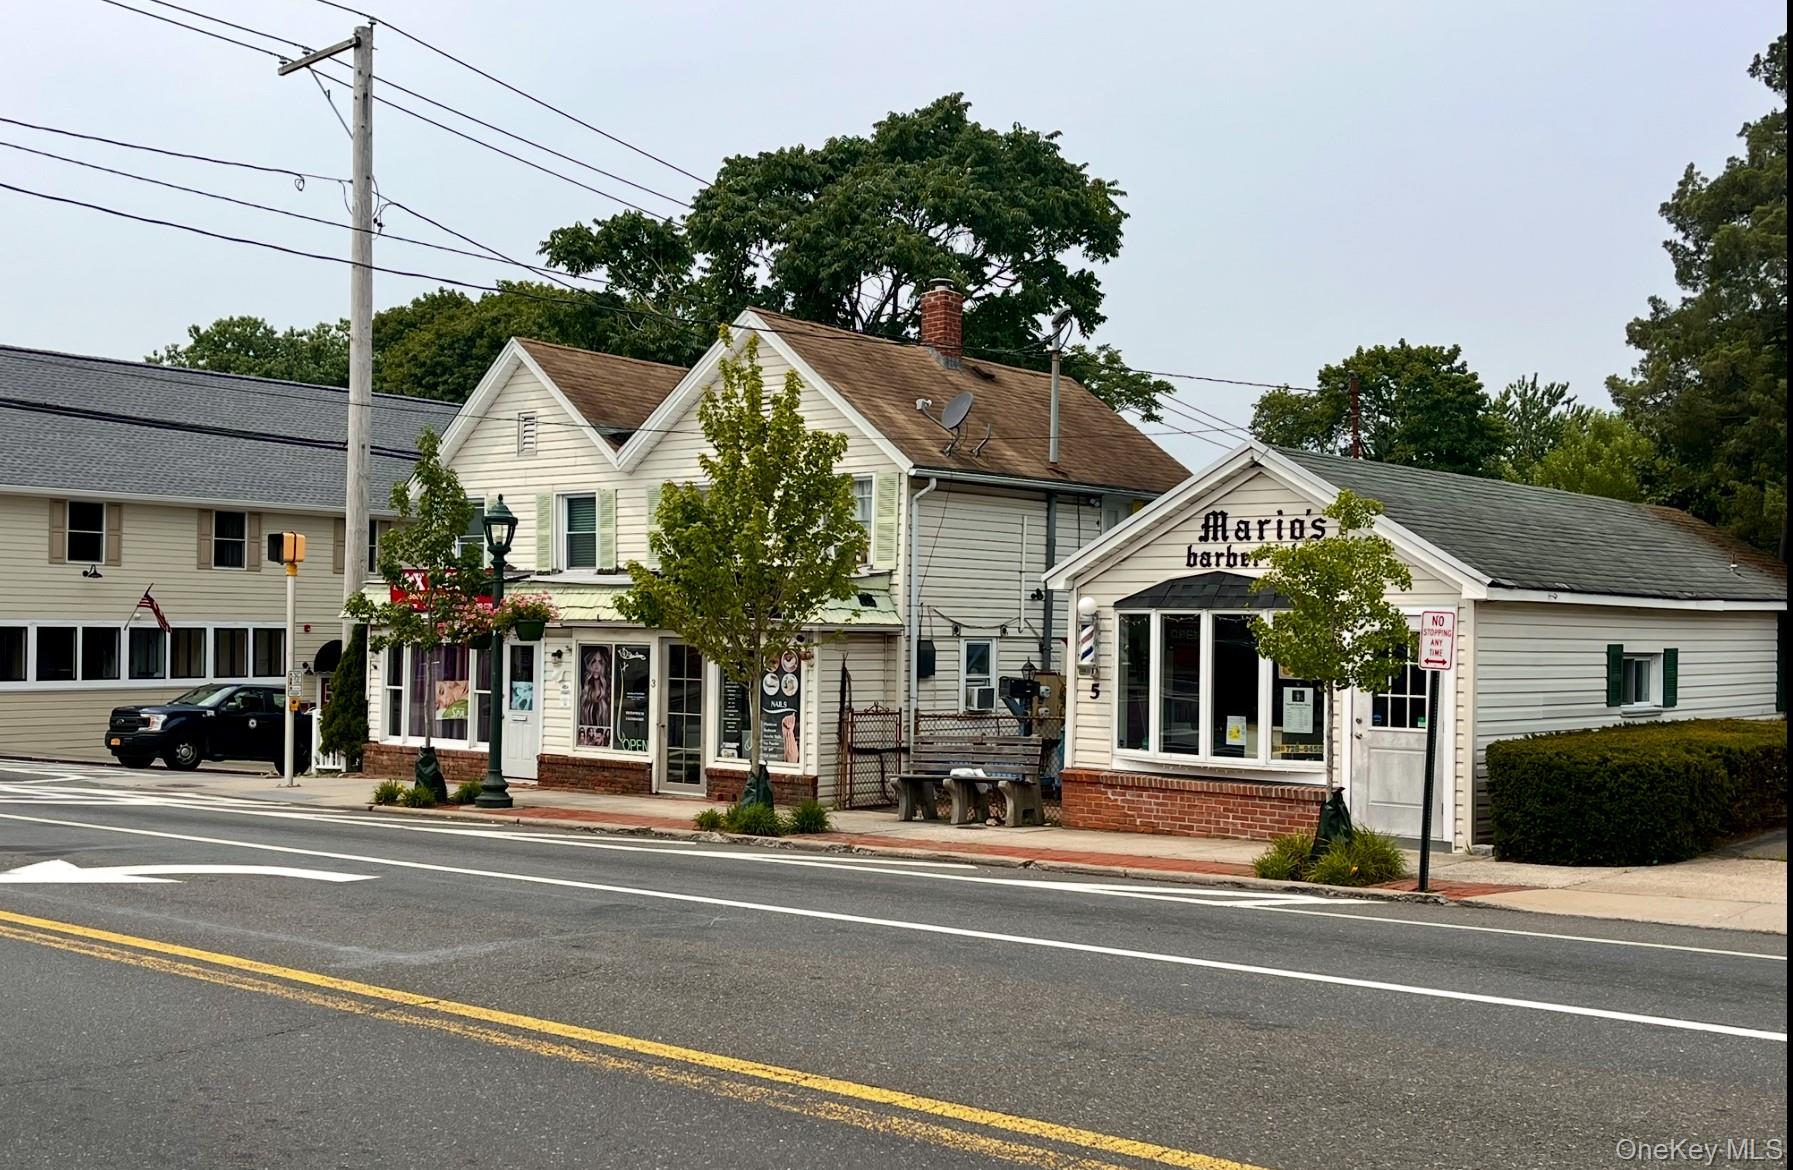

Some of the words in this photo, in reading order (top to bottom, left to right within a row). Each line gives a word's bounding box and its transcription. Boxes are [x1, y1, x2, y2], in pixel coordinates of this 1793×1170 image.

[1198, 509, 1327, 542] Mario's
[1431, 615, 1445, 627] NO
[1423, 628, 1452, 638] STOPPING
[1430, 639, 1443, 647] ANY
[1429, 648, 1443, 657] TIME
[650, 679, 657, 688] 3
[1089, 683, 1101, 700] 5
[770, 700, 788, 708] NAILS
[622, 738, 649, 752] OPEN
